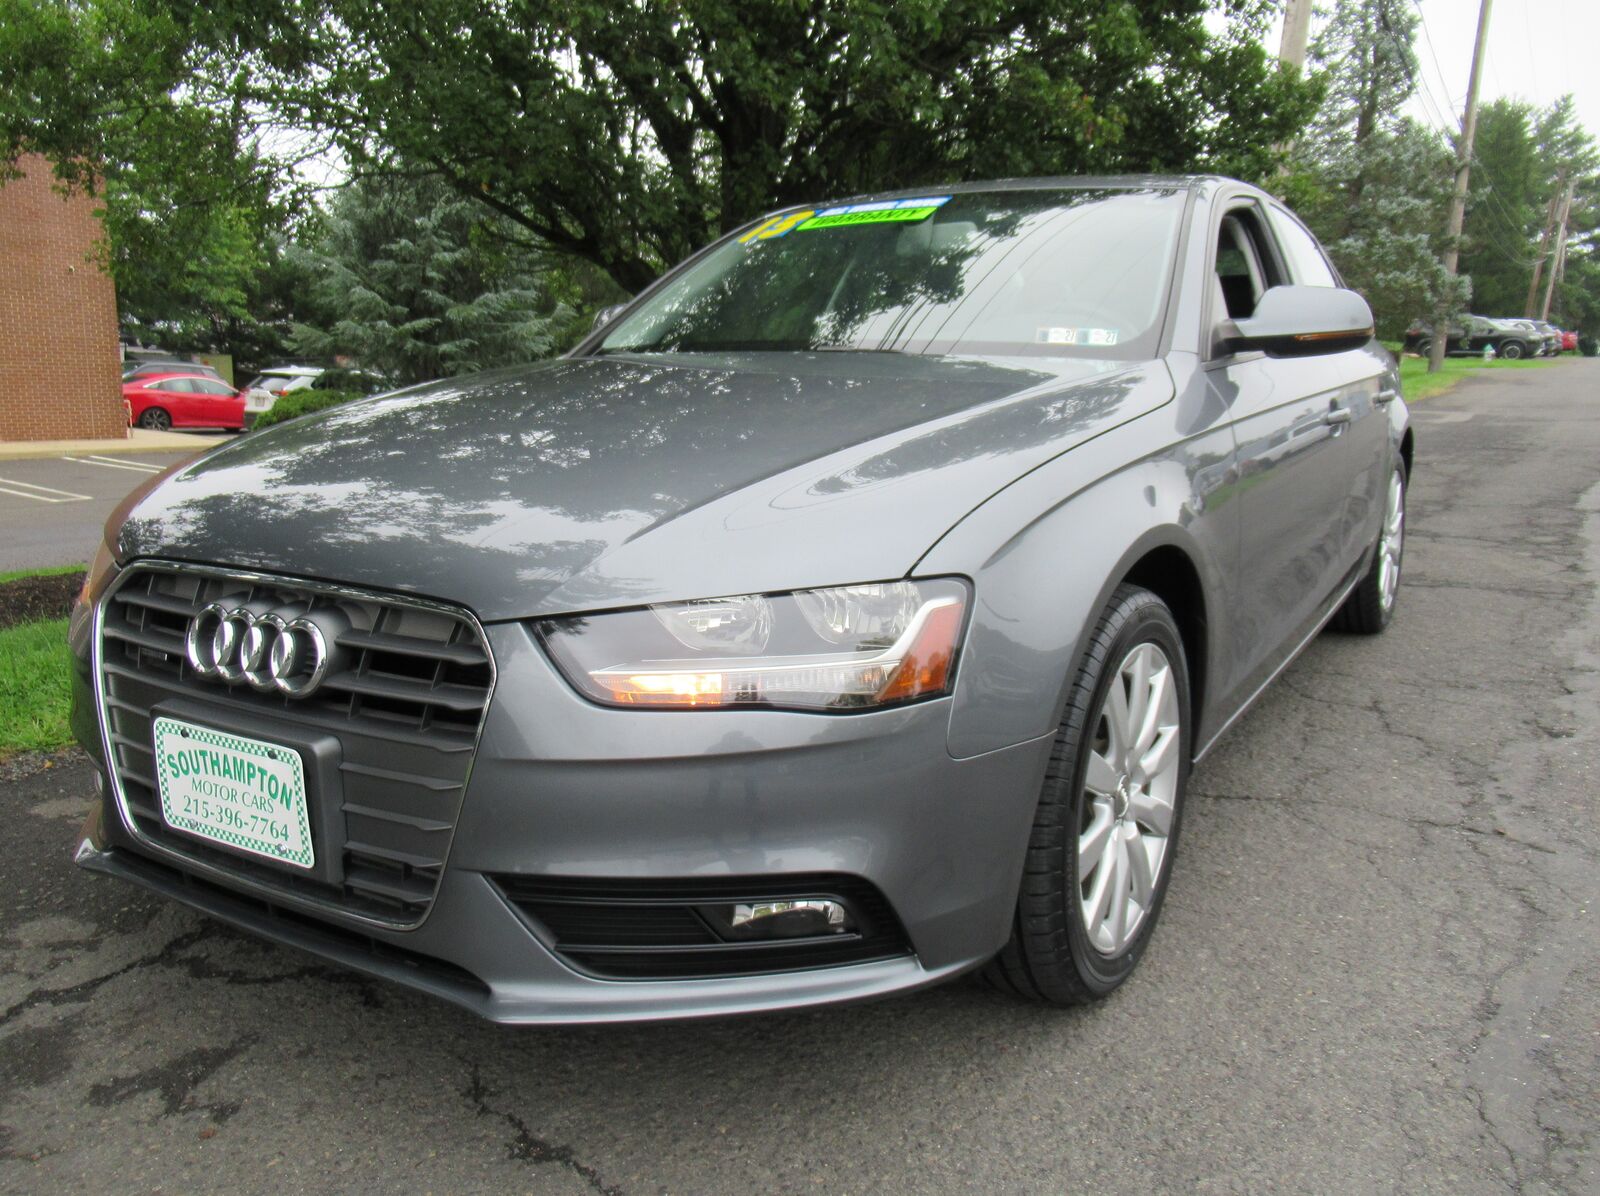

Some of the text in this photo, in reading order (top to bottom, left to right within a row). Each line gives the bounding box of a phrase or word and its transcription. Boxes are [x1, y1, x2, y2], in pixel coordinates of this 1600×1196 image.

[167, 750, 293, 811] SOUTHAMPTON
[191, 778, 274, 814] MOTOR CARS
[183, 795, 290, 842] 215-396-7764
